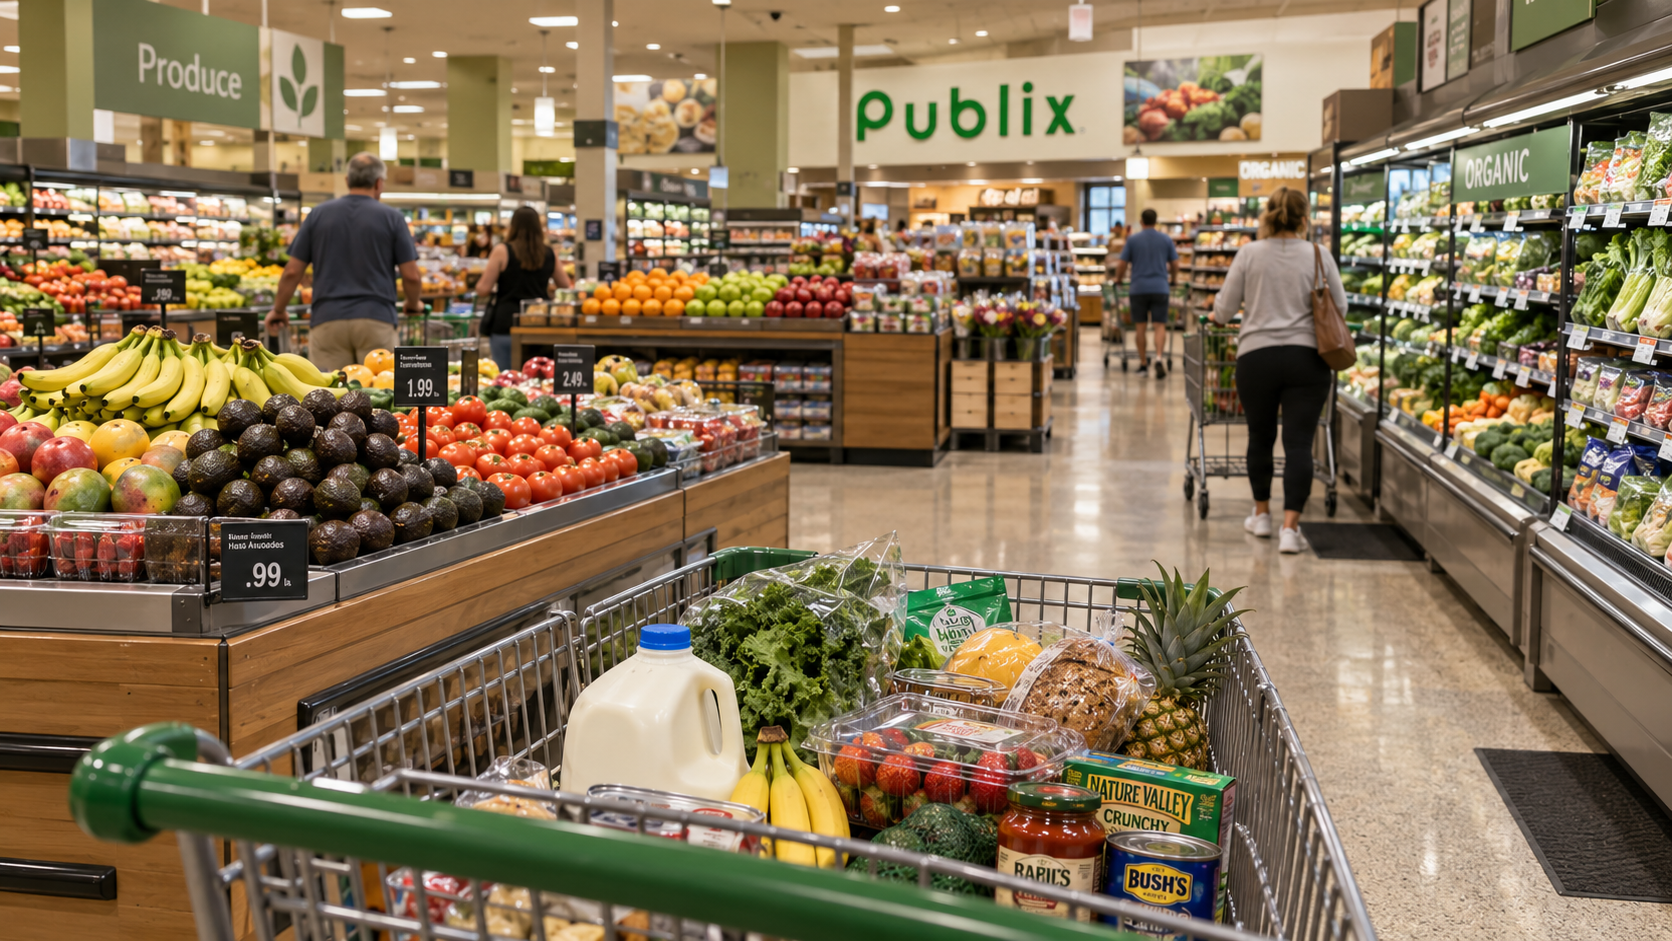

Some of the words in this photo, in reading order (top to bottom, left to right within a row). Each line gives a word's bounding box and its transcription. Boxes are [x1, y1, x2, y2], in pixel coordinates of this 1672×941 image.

[138, 42, 242, 100] Produce
[857, 81, 1076, 141] Publix
[1239, 161, 1306, 180] ORGANIC
[1465, 148, 1530, 190] ORGANIC
[407, 378, 433, 397] 1.99
[562, 371, 583, 387] 2.49
[246, 562, 282, 588] .99
[1090, 775, 1141, 804] NATURE
[1143, 785, 1192, 820] VALLEY
[1103, 808, 1170, 832] CRUNCHY
[1128, 868, 1188, 896] BUSH'S
